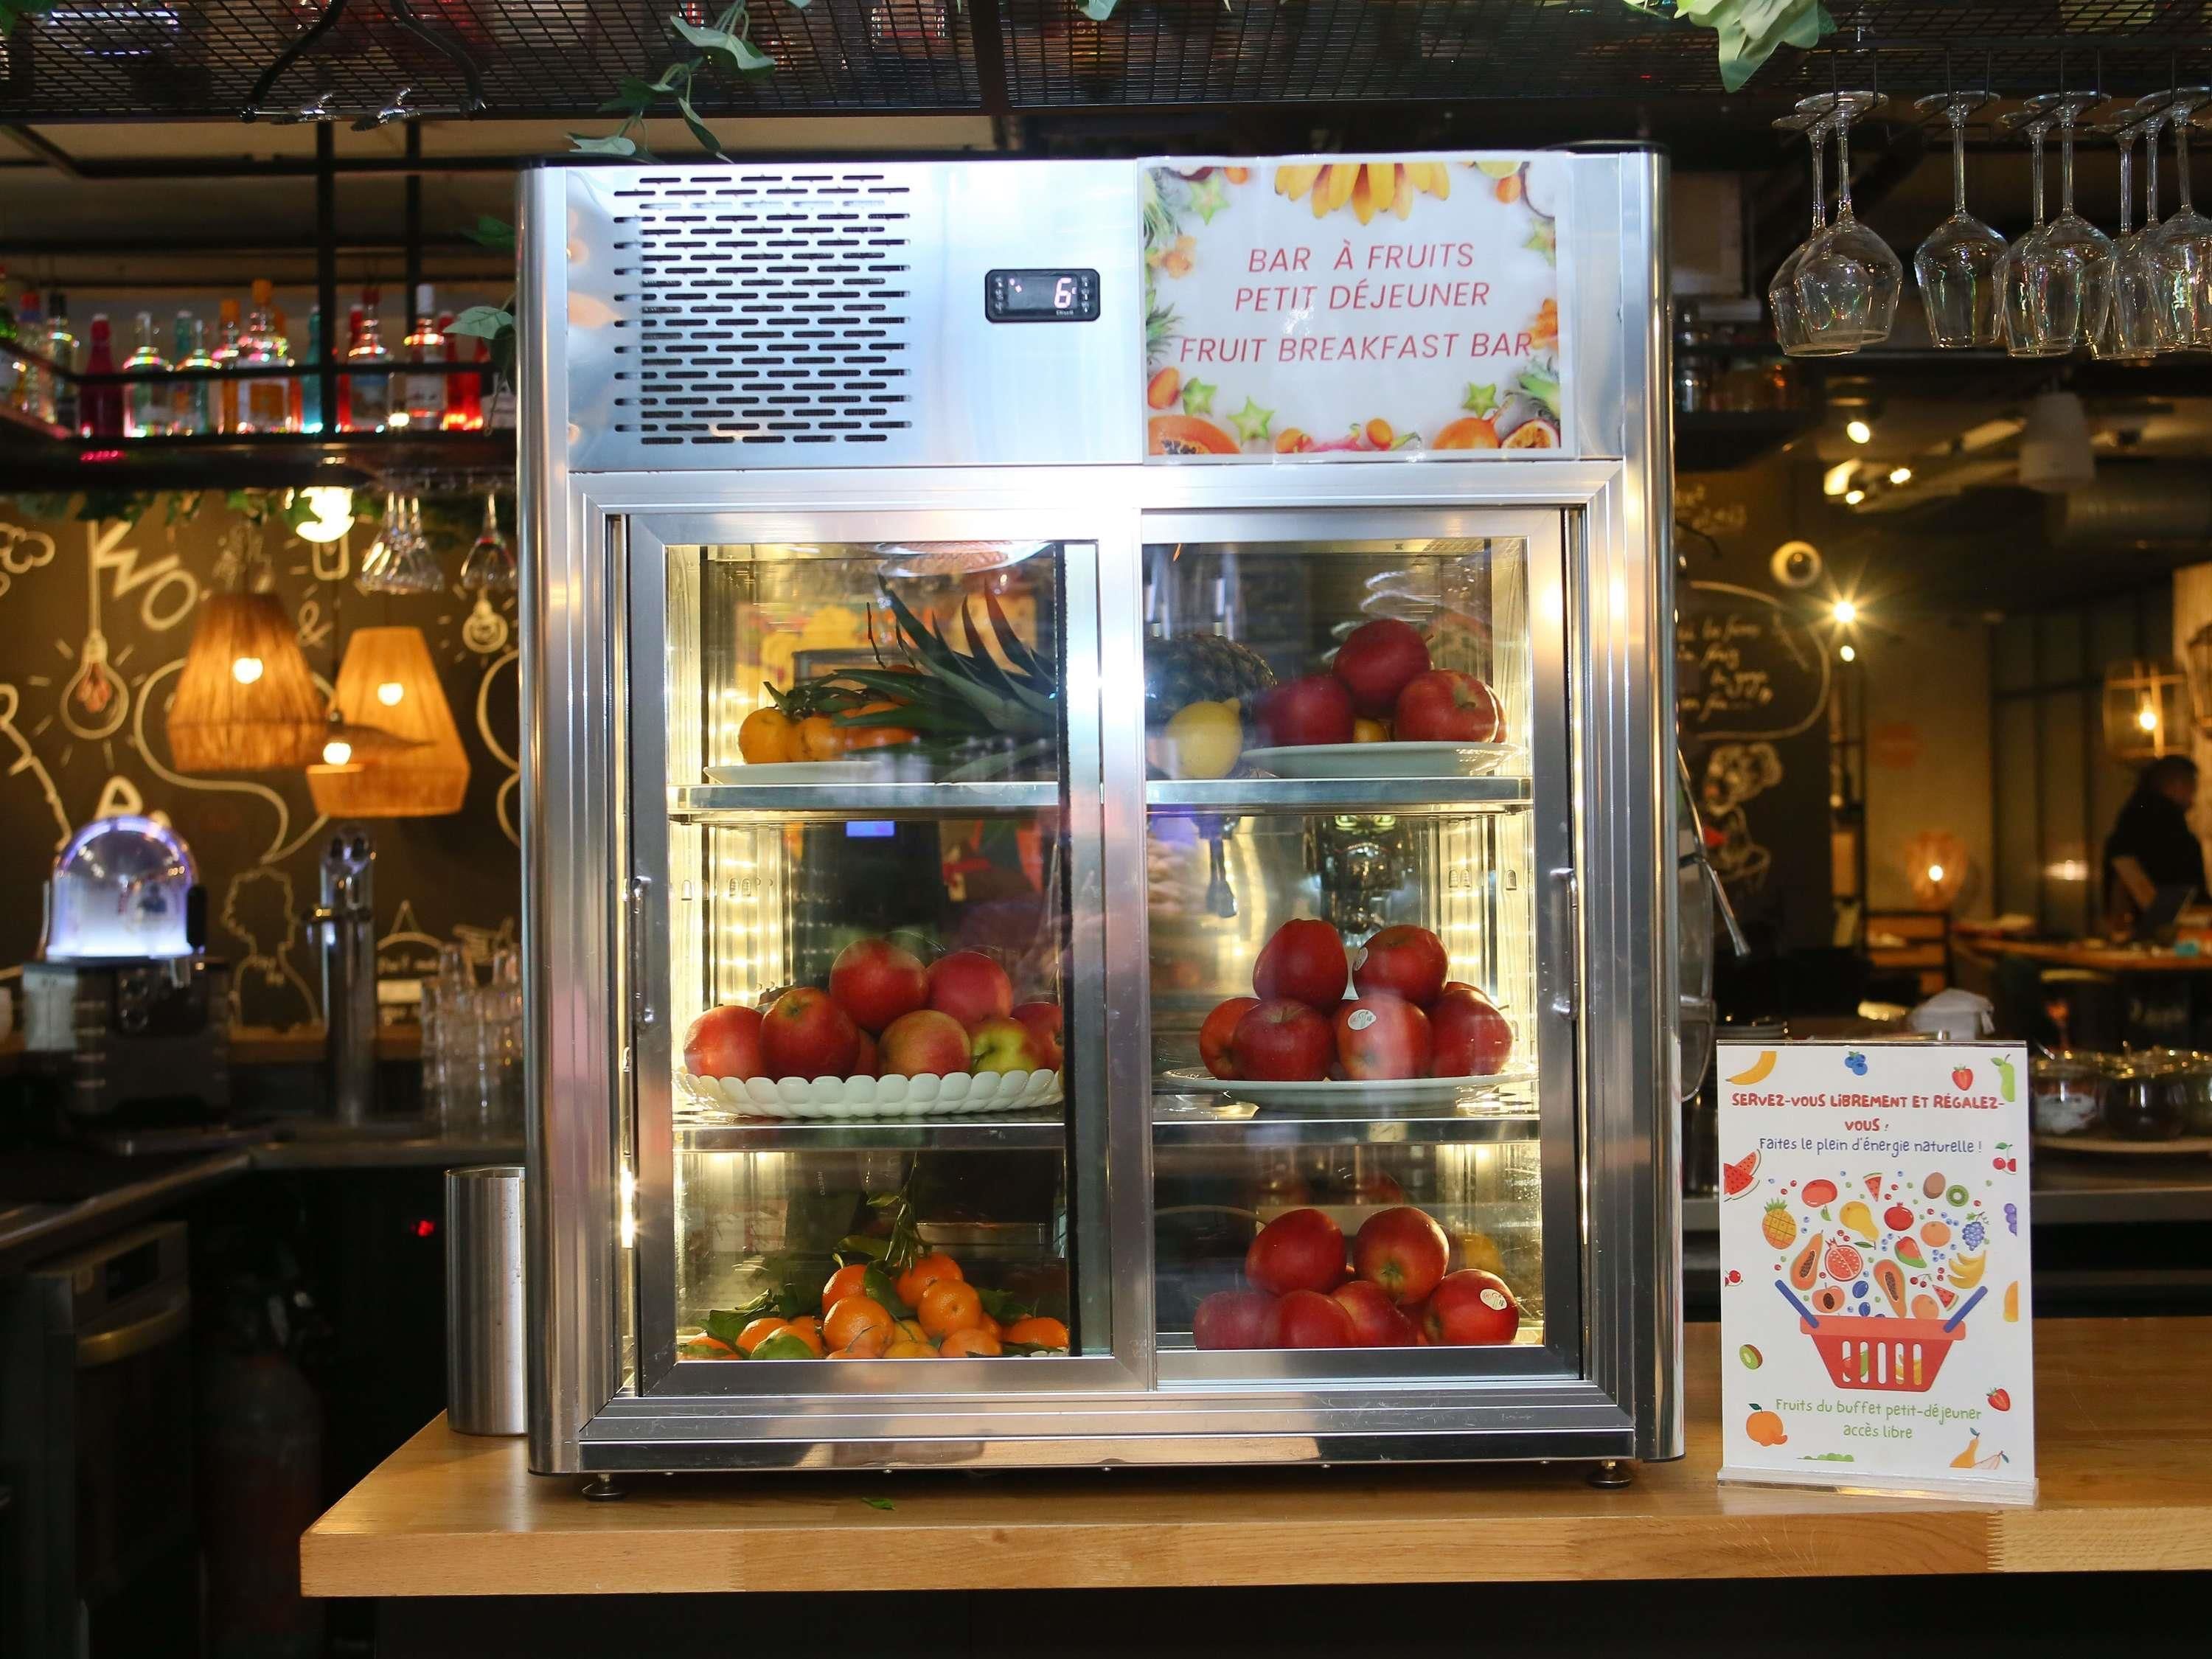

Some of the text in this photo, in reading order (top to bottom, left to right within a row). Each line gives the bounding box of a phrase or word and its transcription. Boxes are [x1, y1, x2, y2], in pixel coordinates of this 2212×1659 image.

[1248, 240, 1474, 273] BAR À FRUITS
[1054, 276, 1072, 309] 6
[1234, 278, 1490, 312] PETIT DÉJEUNER
[1180, 331, 1533, 363] FRUIT BREAKFAST BAR
[1912, 1095, 1929, 1108] ET
[1759, 1138, 1797, 1150] Faites
[1801, 1138, 1813, 1150] le
[1817, 1138, 1848, 1155] plein
[1851, 1136, 1910, 1158] d'énergie
[1914, 1140, 1974, 1153] naturelle
[1775, 1398, 1983, 1425] Fruits du buffet petit-déjeuner
[1843, 1422, 1913, 1439] accès libre
